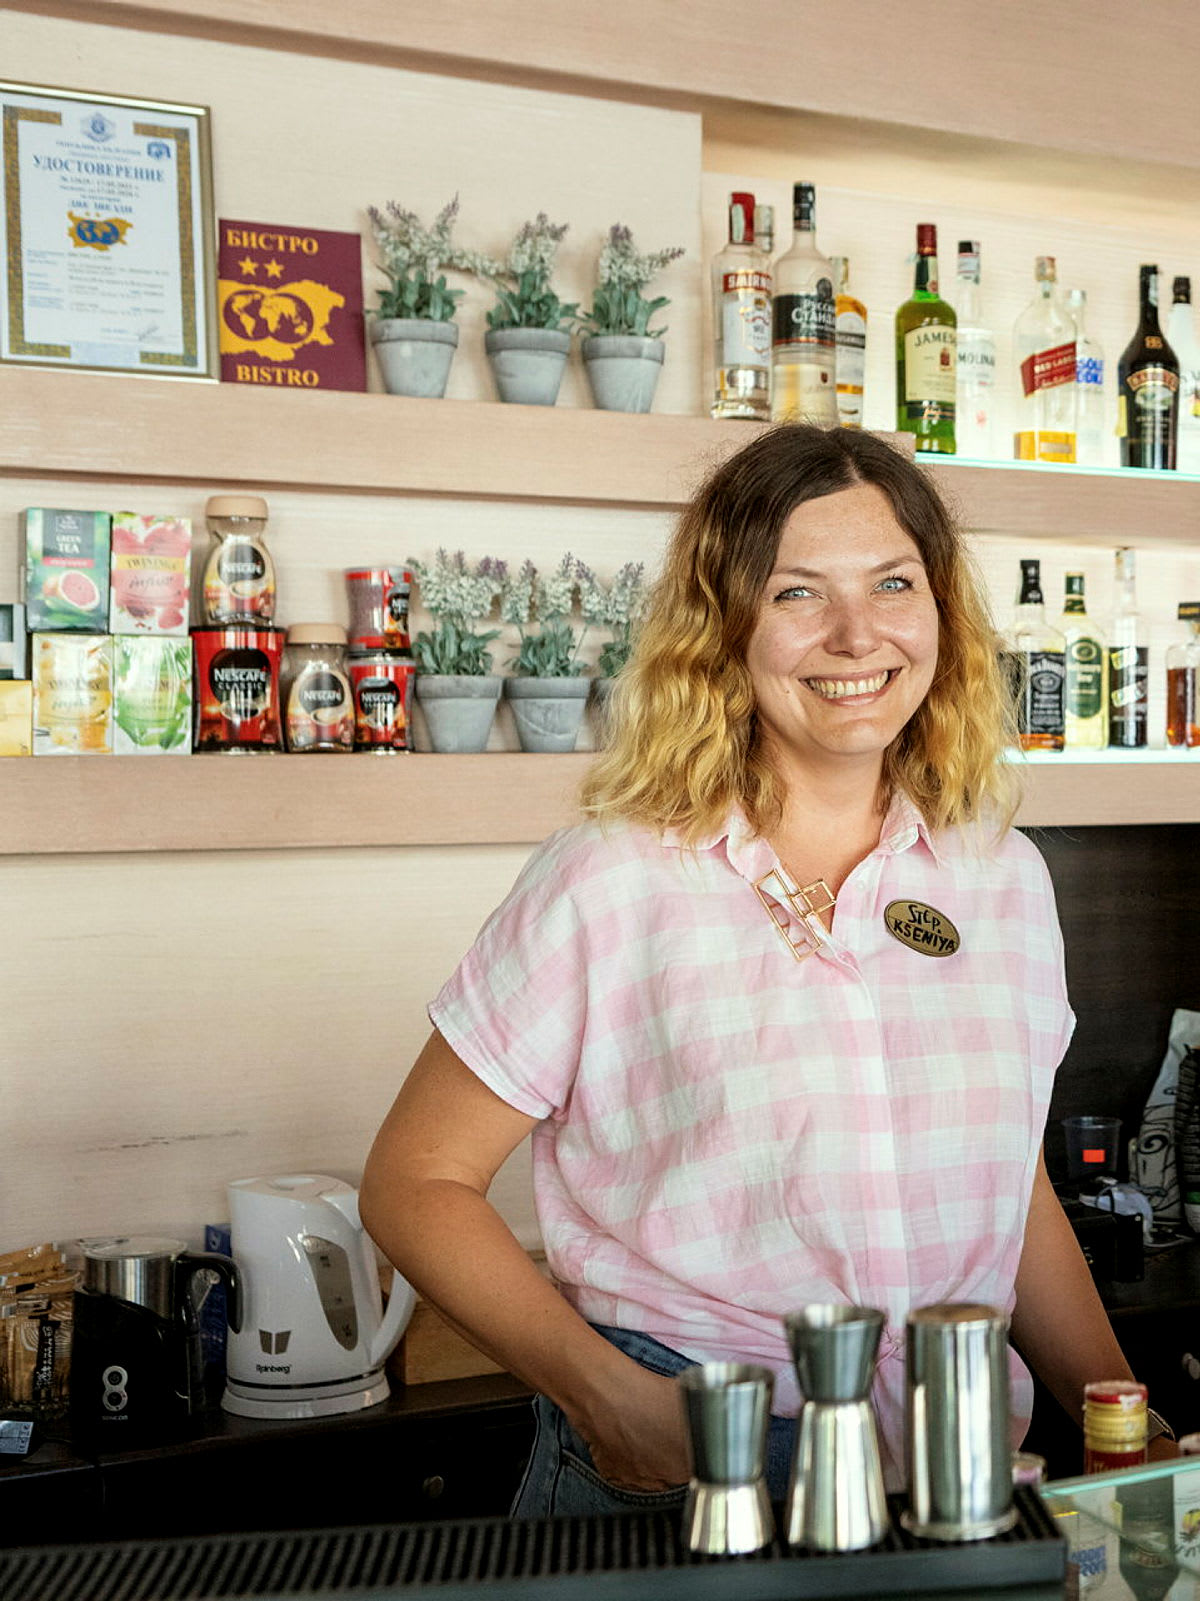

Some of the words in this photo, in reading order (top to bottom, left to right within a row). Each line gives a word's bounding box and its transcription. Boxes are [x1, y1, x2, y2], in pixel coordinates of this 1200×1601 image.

[226, 228, 320, 255] БИСТРО
[236, 364, 320, 388] BISTRO
[58, 543, 81, 554] TEA
[894, 919, 956, 953] KSENIYA
